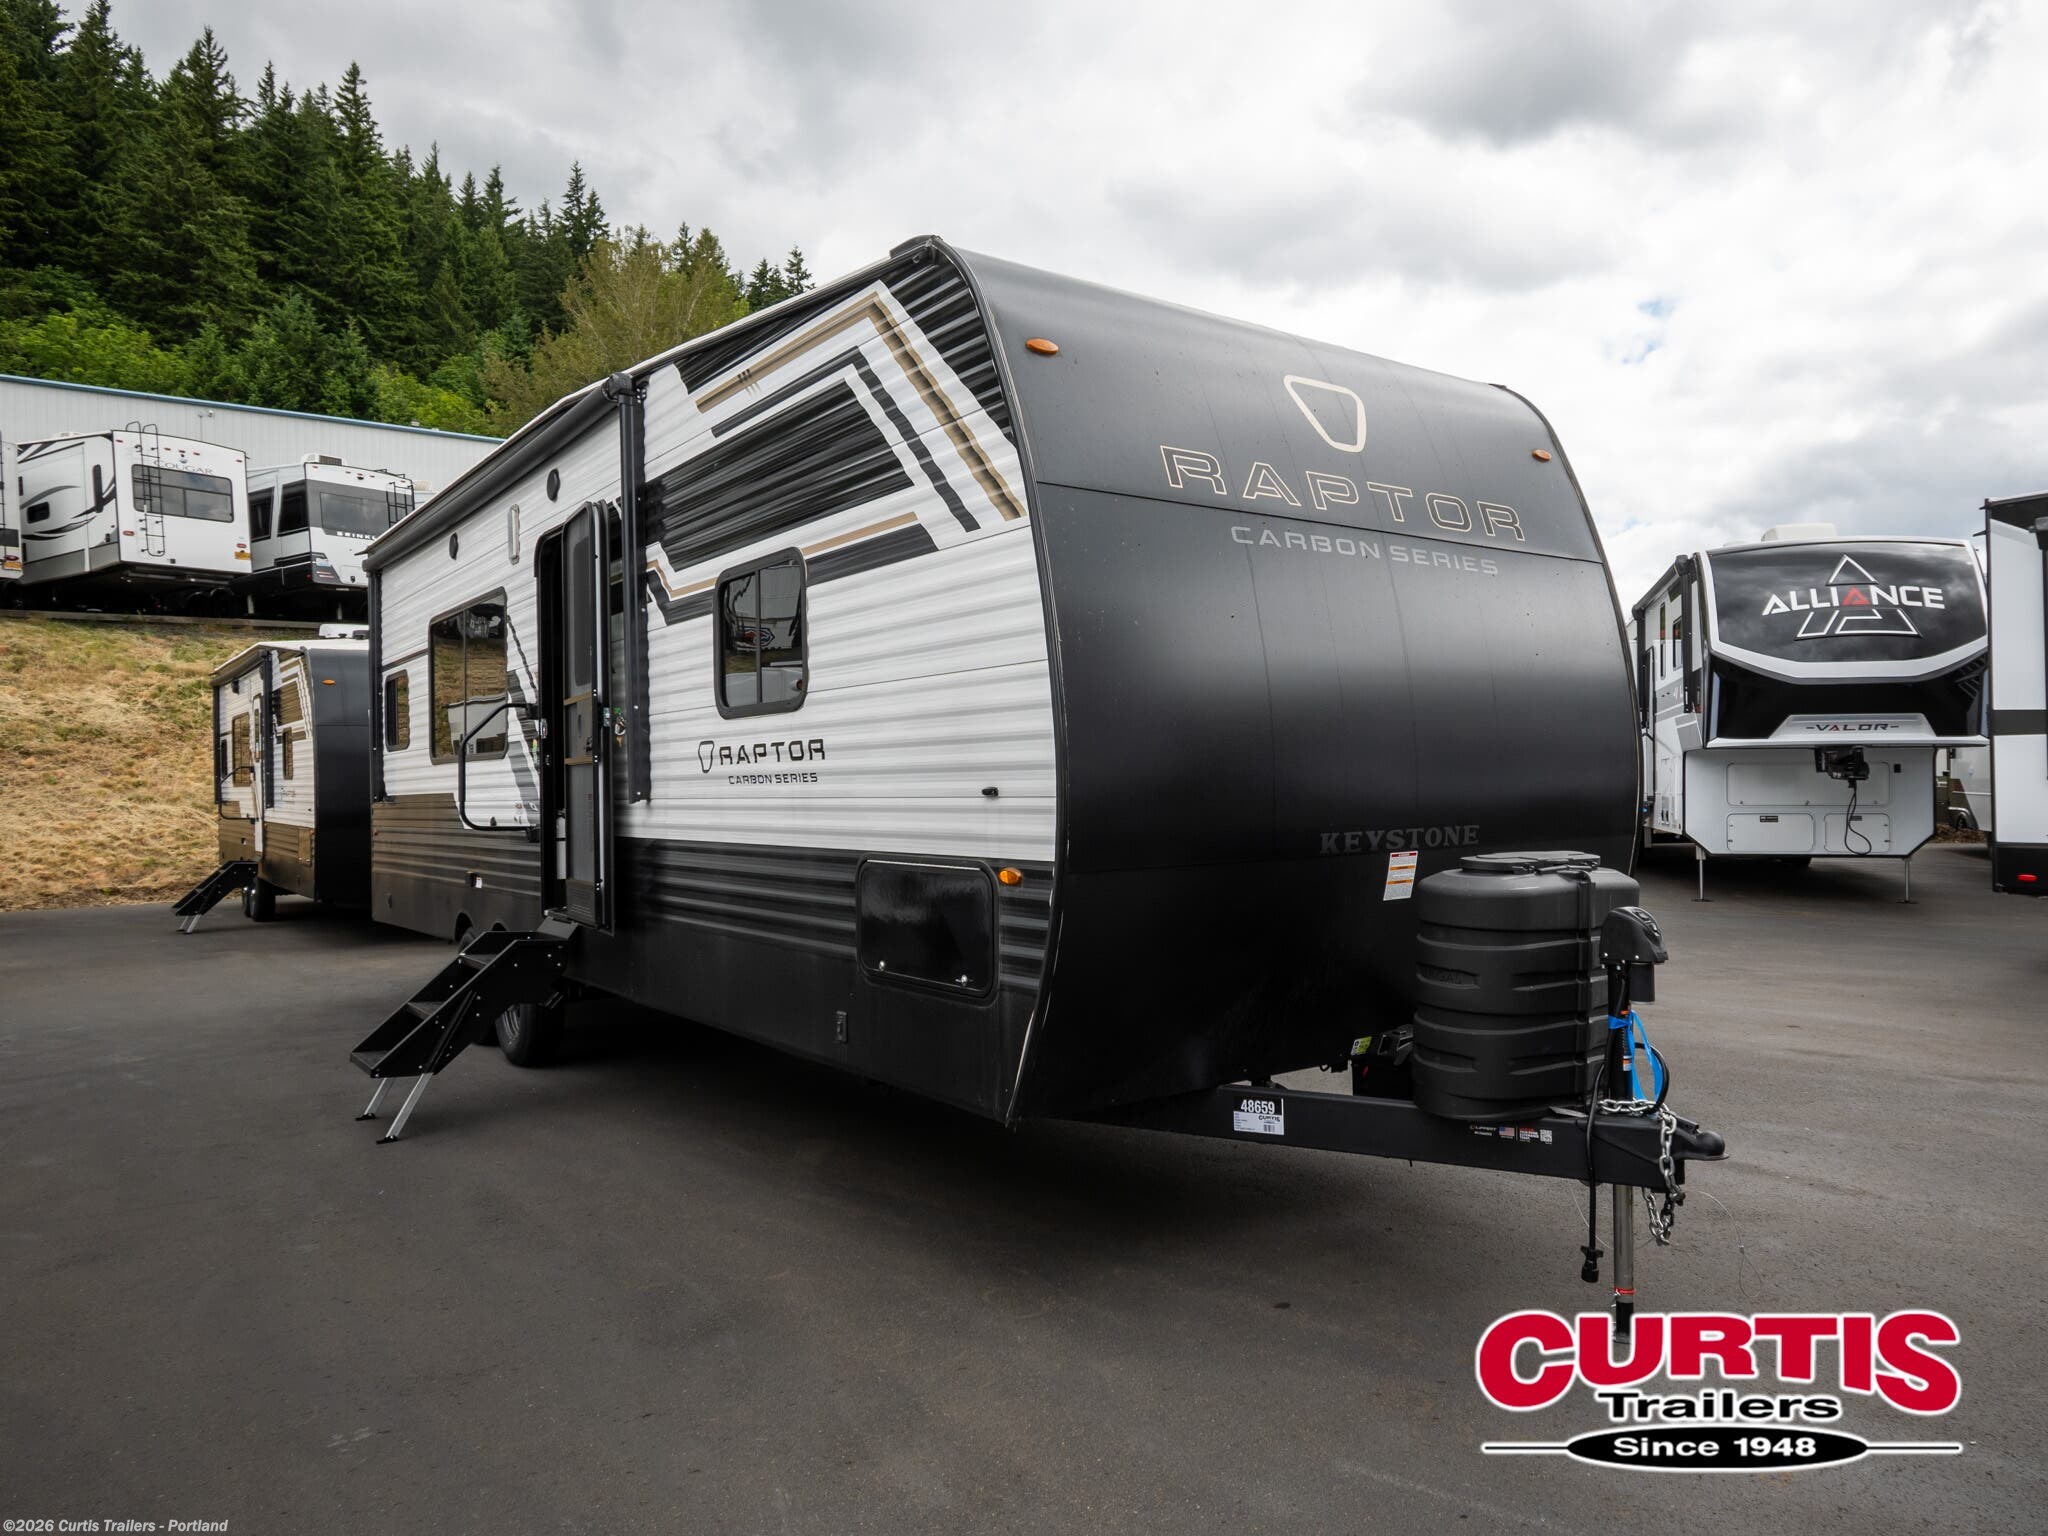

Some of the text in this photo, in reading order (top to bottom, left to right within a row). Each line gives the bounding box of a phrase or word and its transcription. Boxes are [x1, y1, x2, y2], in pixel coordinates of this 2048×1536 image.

[153, 460, 213, 475] COUGAR
[1160, 445, 1526, 542] RAPTOR
[1231, 526, 1499, 575] CARBON SERIES
[1762, 585, 1945, 616] ALLIANCE
[719, 738, 825, 766] RAPTOR
[728, 772, 818, 785] CARBON SERIES
[1319, 825, 1480, 854] KEYSTONE
[1240, 1099, 1275, 1115] 48659
